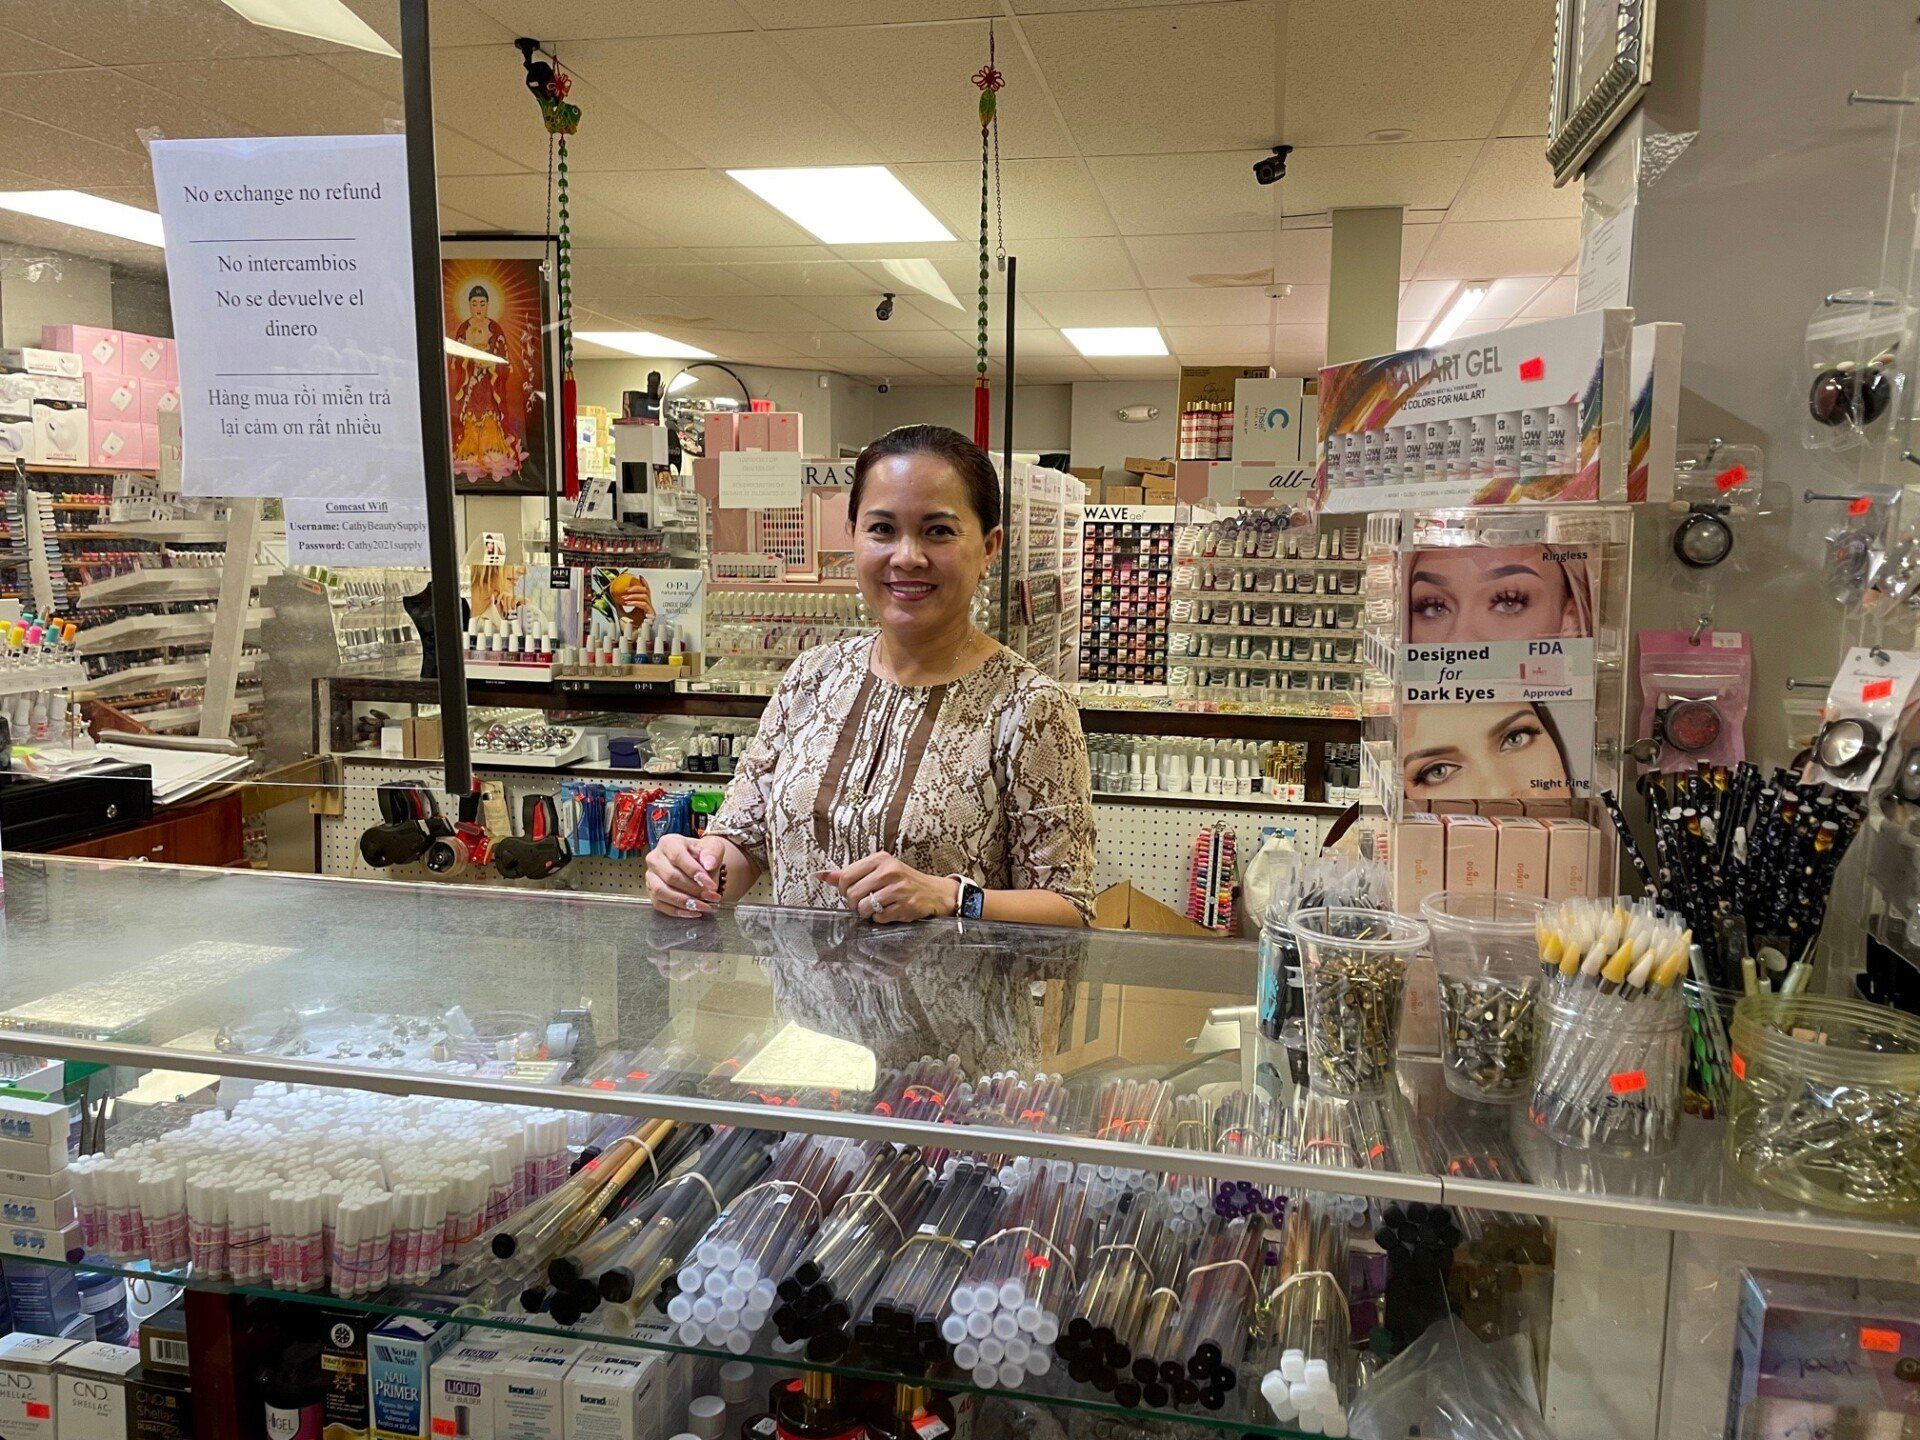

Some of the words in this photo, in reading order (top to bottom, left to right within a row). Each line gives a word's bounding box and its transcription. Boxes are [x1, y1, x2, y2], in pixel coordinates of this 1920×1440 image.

[184, 186, 209, 203] No
[214, 185, 294, 206] exchange
[299, 188, 320, 201] no
[326, 183, 381, 200] refund
[218, 255, 242, 272] No
[249, 254, 357, 271] intercambios
[216, 291, 241, 307] No
[246, 294, 262, 306] se
[268, 289, 343, 306] devuelve
[349, 289, 364, 306] el
[265, 320, 317, 337] dinero
[1427, 354, 1460, 384] ART
[1466, 346, 1503, 378] GEL
[208, 389, 256, 410] Hàng
[255, 393, 289, 405] mua
[295, 384, 316, 405] rồi
[1408, 397, 1435, 410] COLORS
[1438, 394, 1453, 406] FOR
[1453, 391, 1470, 403] NAIL
[1470, 389, 1486, 401] ART
[221, 419, 239, 437] lại
[245, 418, 277, 434] cảm
[283, 420, 303, 434] ơn
[309, 414, 330, 434] rất
[336, 414, 381, 434] nhiều
[325, 502, 366, 512] Comcast
[368, 501, 388, 512] Wifi
[1084, 507, 1128, 520] WAVE
[290, 522, 339, 531] Username:
[342, 521, 426, 533] CathyBeautySupply
[299, 541, 345, 551] Password:
[347, 540, 423, 551] Cathy2021supply
[1542, 551, 1588, 564] Ringless
[1407, 647, 1490, 664] Designed
[1528, 641, 1564, 656] FDA
[1438, 667, 1463, 684] for
[1407, 686, 1450, 701] Dark
[1455, 686, 1495, 703] Eyes
[1523, 688, 1573, 699] Approved
[1530, 778, 1562, 790] Slight
[1565, 779, 1590, 789] Ring
[395, 1356, 416, 1366] Nails
[402, 1348, 417, 1359] Lift
[385, 1370, 408, 1385] NAIL
[0, 1390, 33, 1401] HELLAC
[73, 1381, 108, 1400] CND
[375, 1379, 419, 1402] PRIMER
[446, 1380, 480, 1396] LIQUID
[507, 1384, 548, 1398] bondaid
[72, 1399, 110, 1412] SHELLAC
[579, 1394, 620, 1409] bondaid
